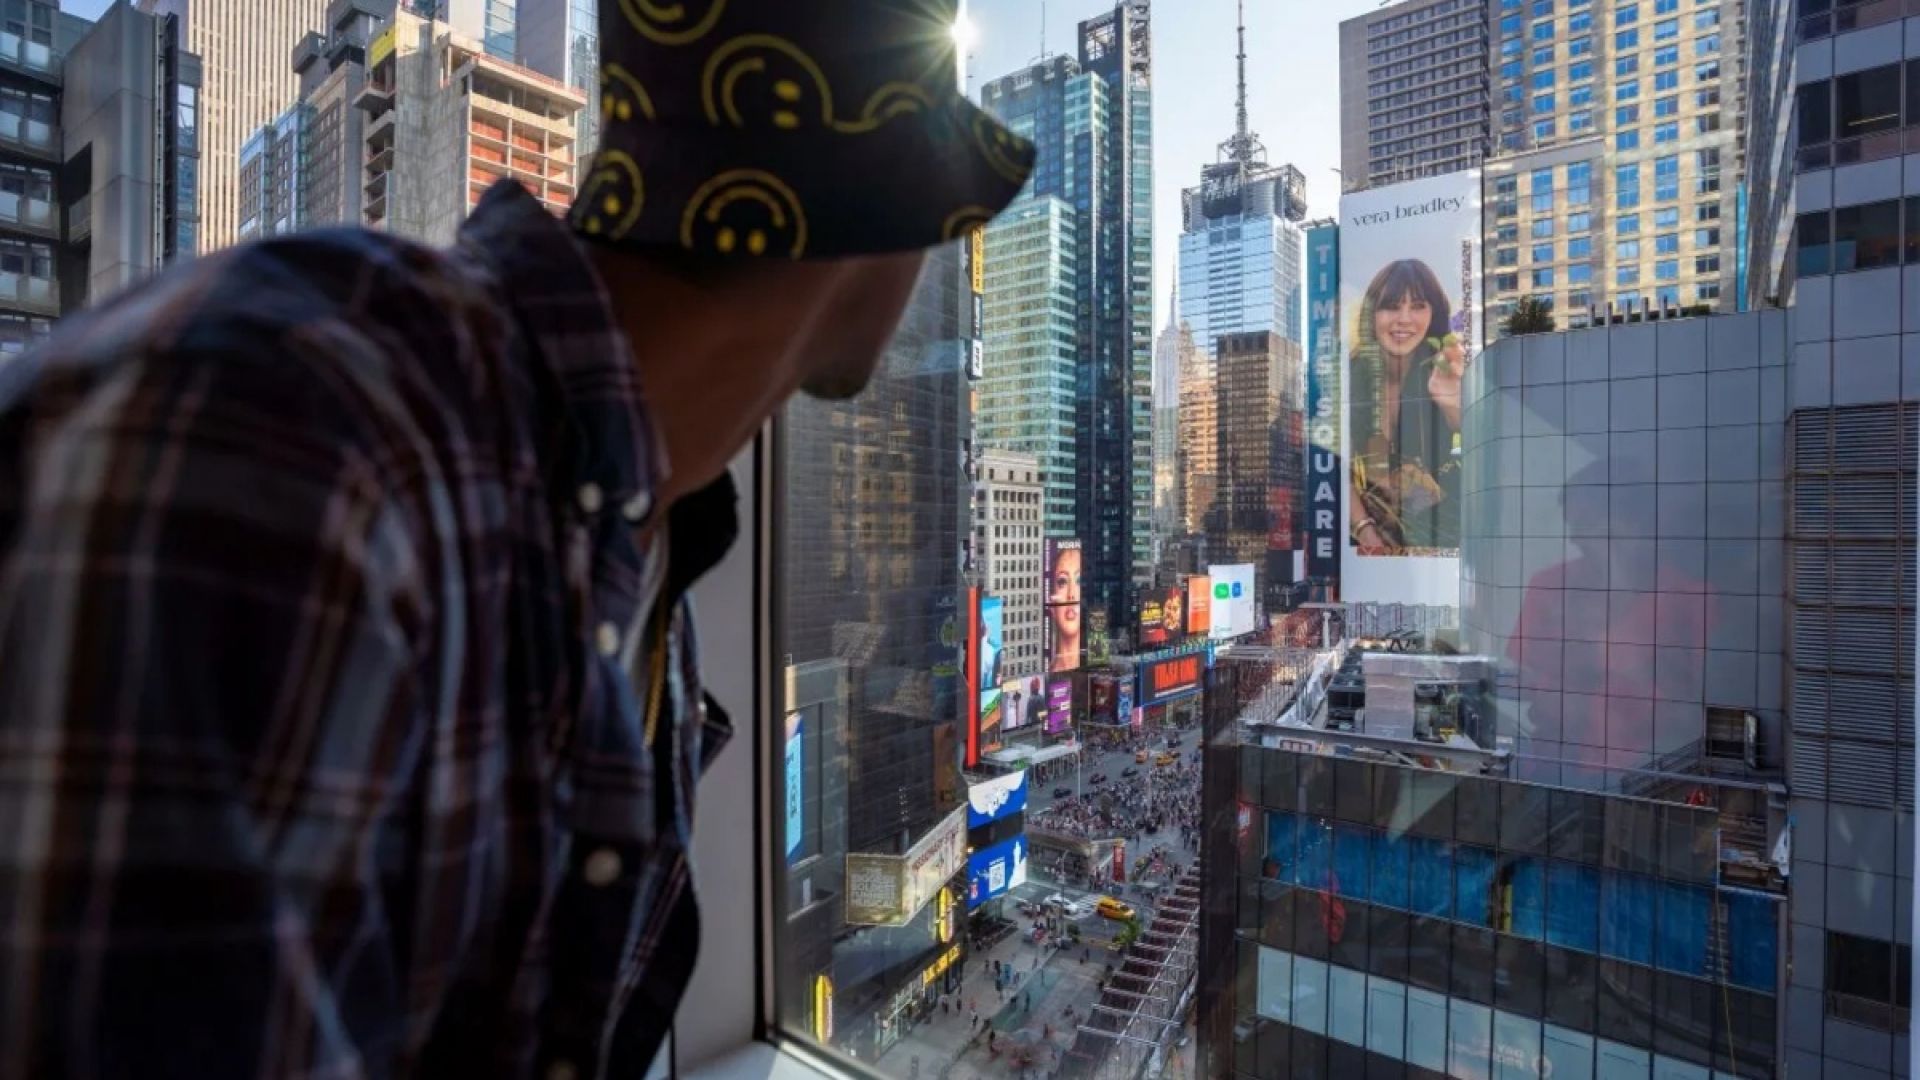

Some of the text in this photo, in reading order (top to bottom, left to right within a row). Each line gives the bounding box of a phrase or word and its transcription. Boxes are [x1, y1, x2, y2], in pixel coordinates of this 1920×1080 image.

[1353, 196, 1465, 227] vera bradley
[1313, 244, 1336, 559] TIMES SQUARE
